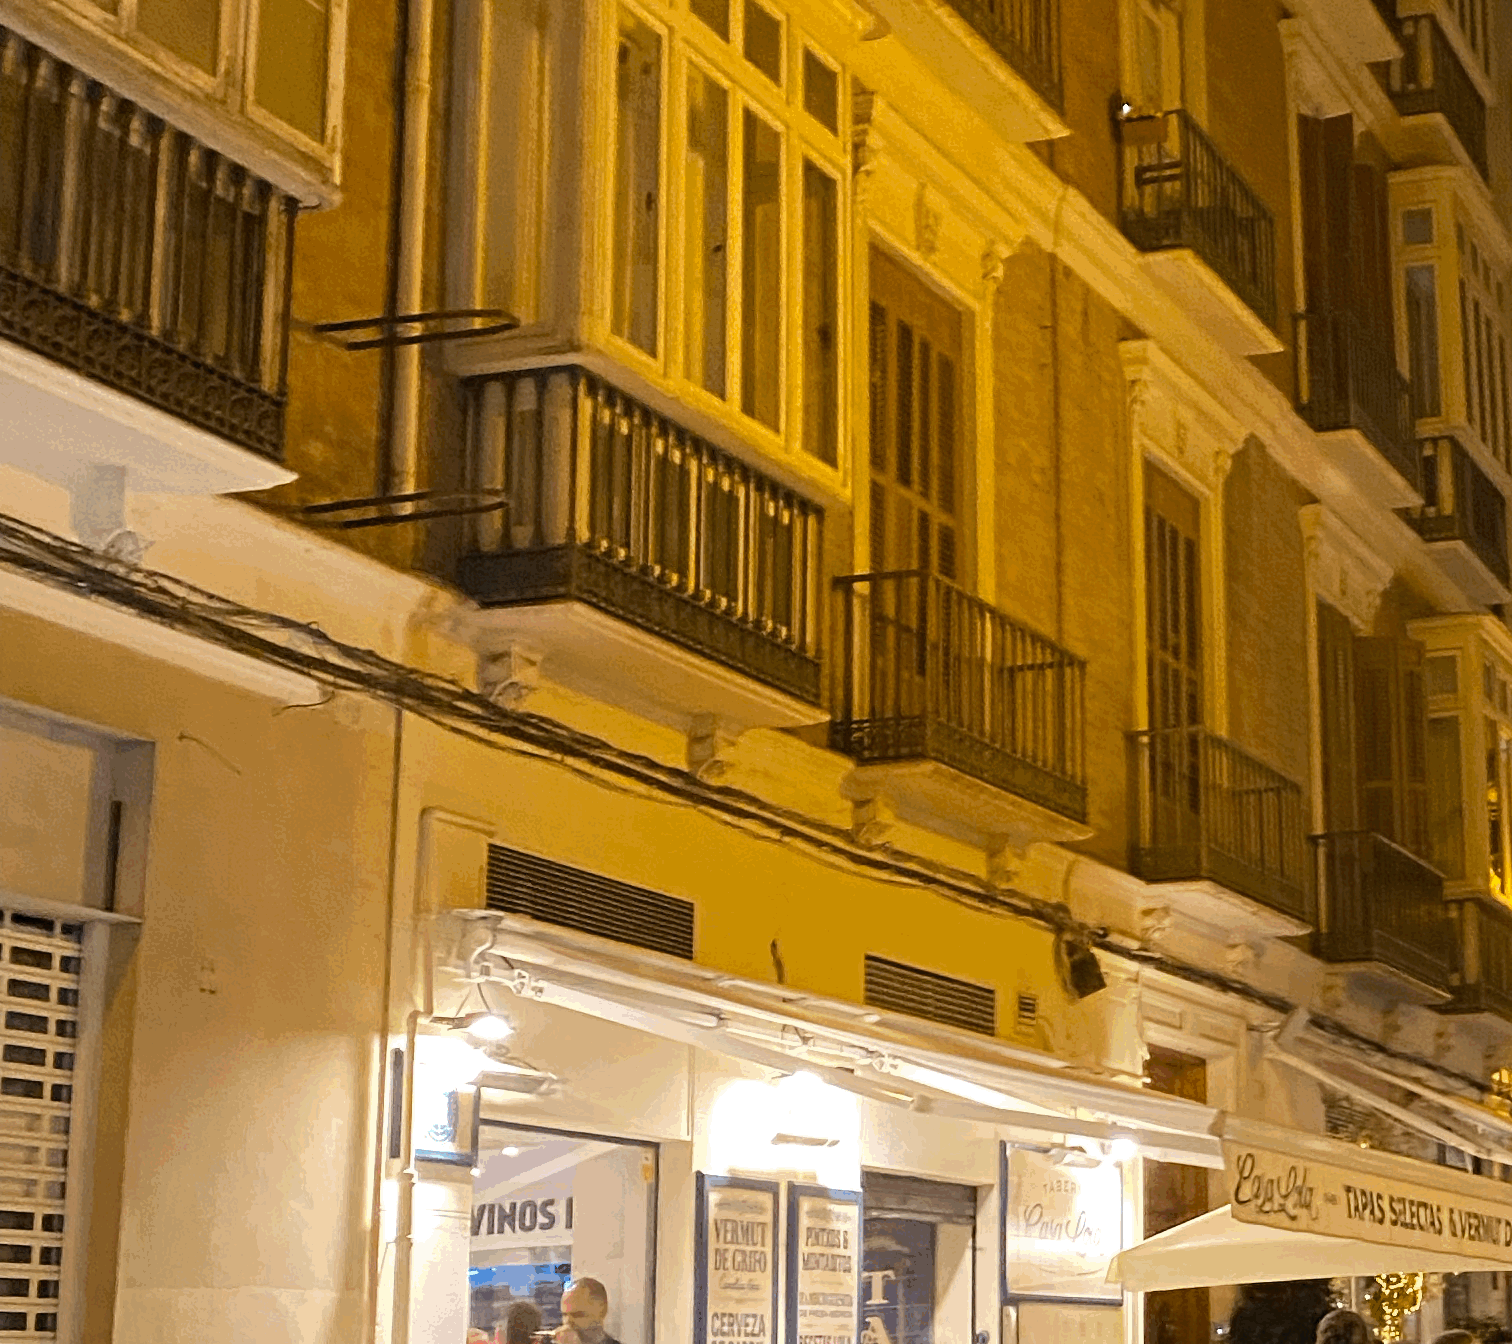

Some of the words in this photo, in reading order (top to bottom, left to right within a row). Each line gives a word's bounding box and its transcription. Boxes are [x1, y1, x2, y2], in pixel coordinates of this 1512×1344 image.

[471, 1198, 556, 1236] VINOS
[1343, 1184, 1386, 1225] TAPAS
[1388, 1193, 1443, 1236] SELECTAS
[713, 1218, 768, 1247] VERMUT
[714, 1248, 729, 1271] DE
[732, 1249, 767, 1273] GRIFO
[710, 1312, 766, 1337] CERVEZA
